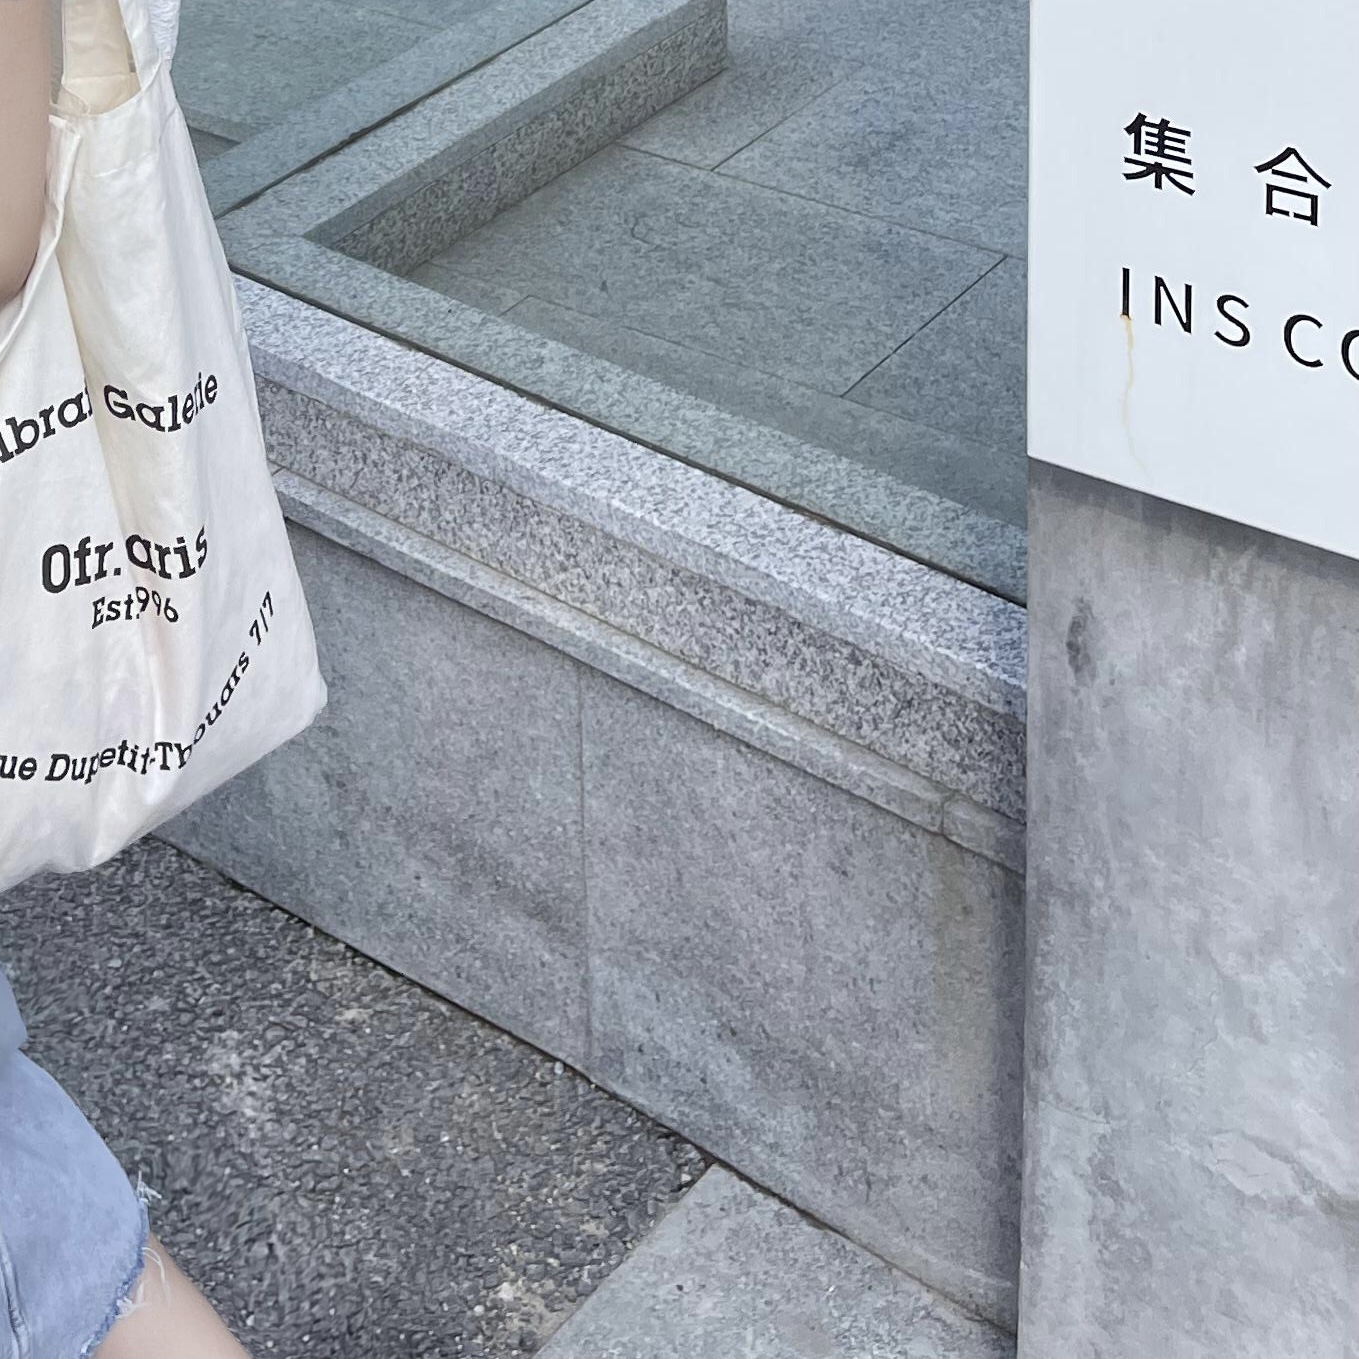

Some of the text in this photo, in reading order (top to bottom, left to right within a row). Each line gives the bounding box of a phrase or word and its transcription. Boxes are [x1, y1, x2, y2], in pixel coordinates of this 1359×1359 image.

[1122, 112, 1332, 227] 集合
[1121, 267, 1251, 347] INS
[125, 525, 207, 579] aris
[91, 586, 179, 629] Est.996
[249, 591, 275, 645] 7/7
